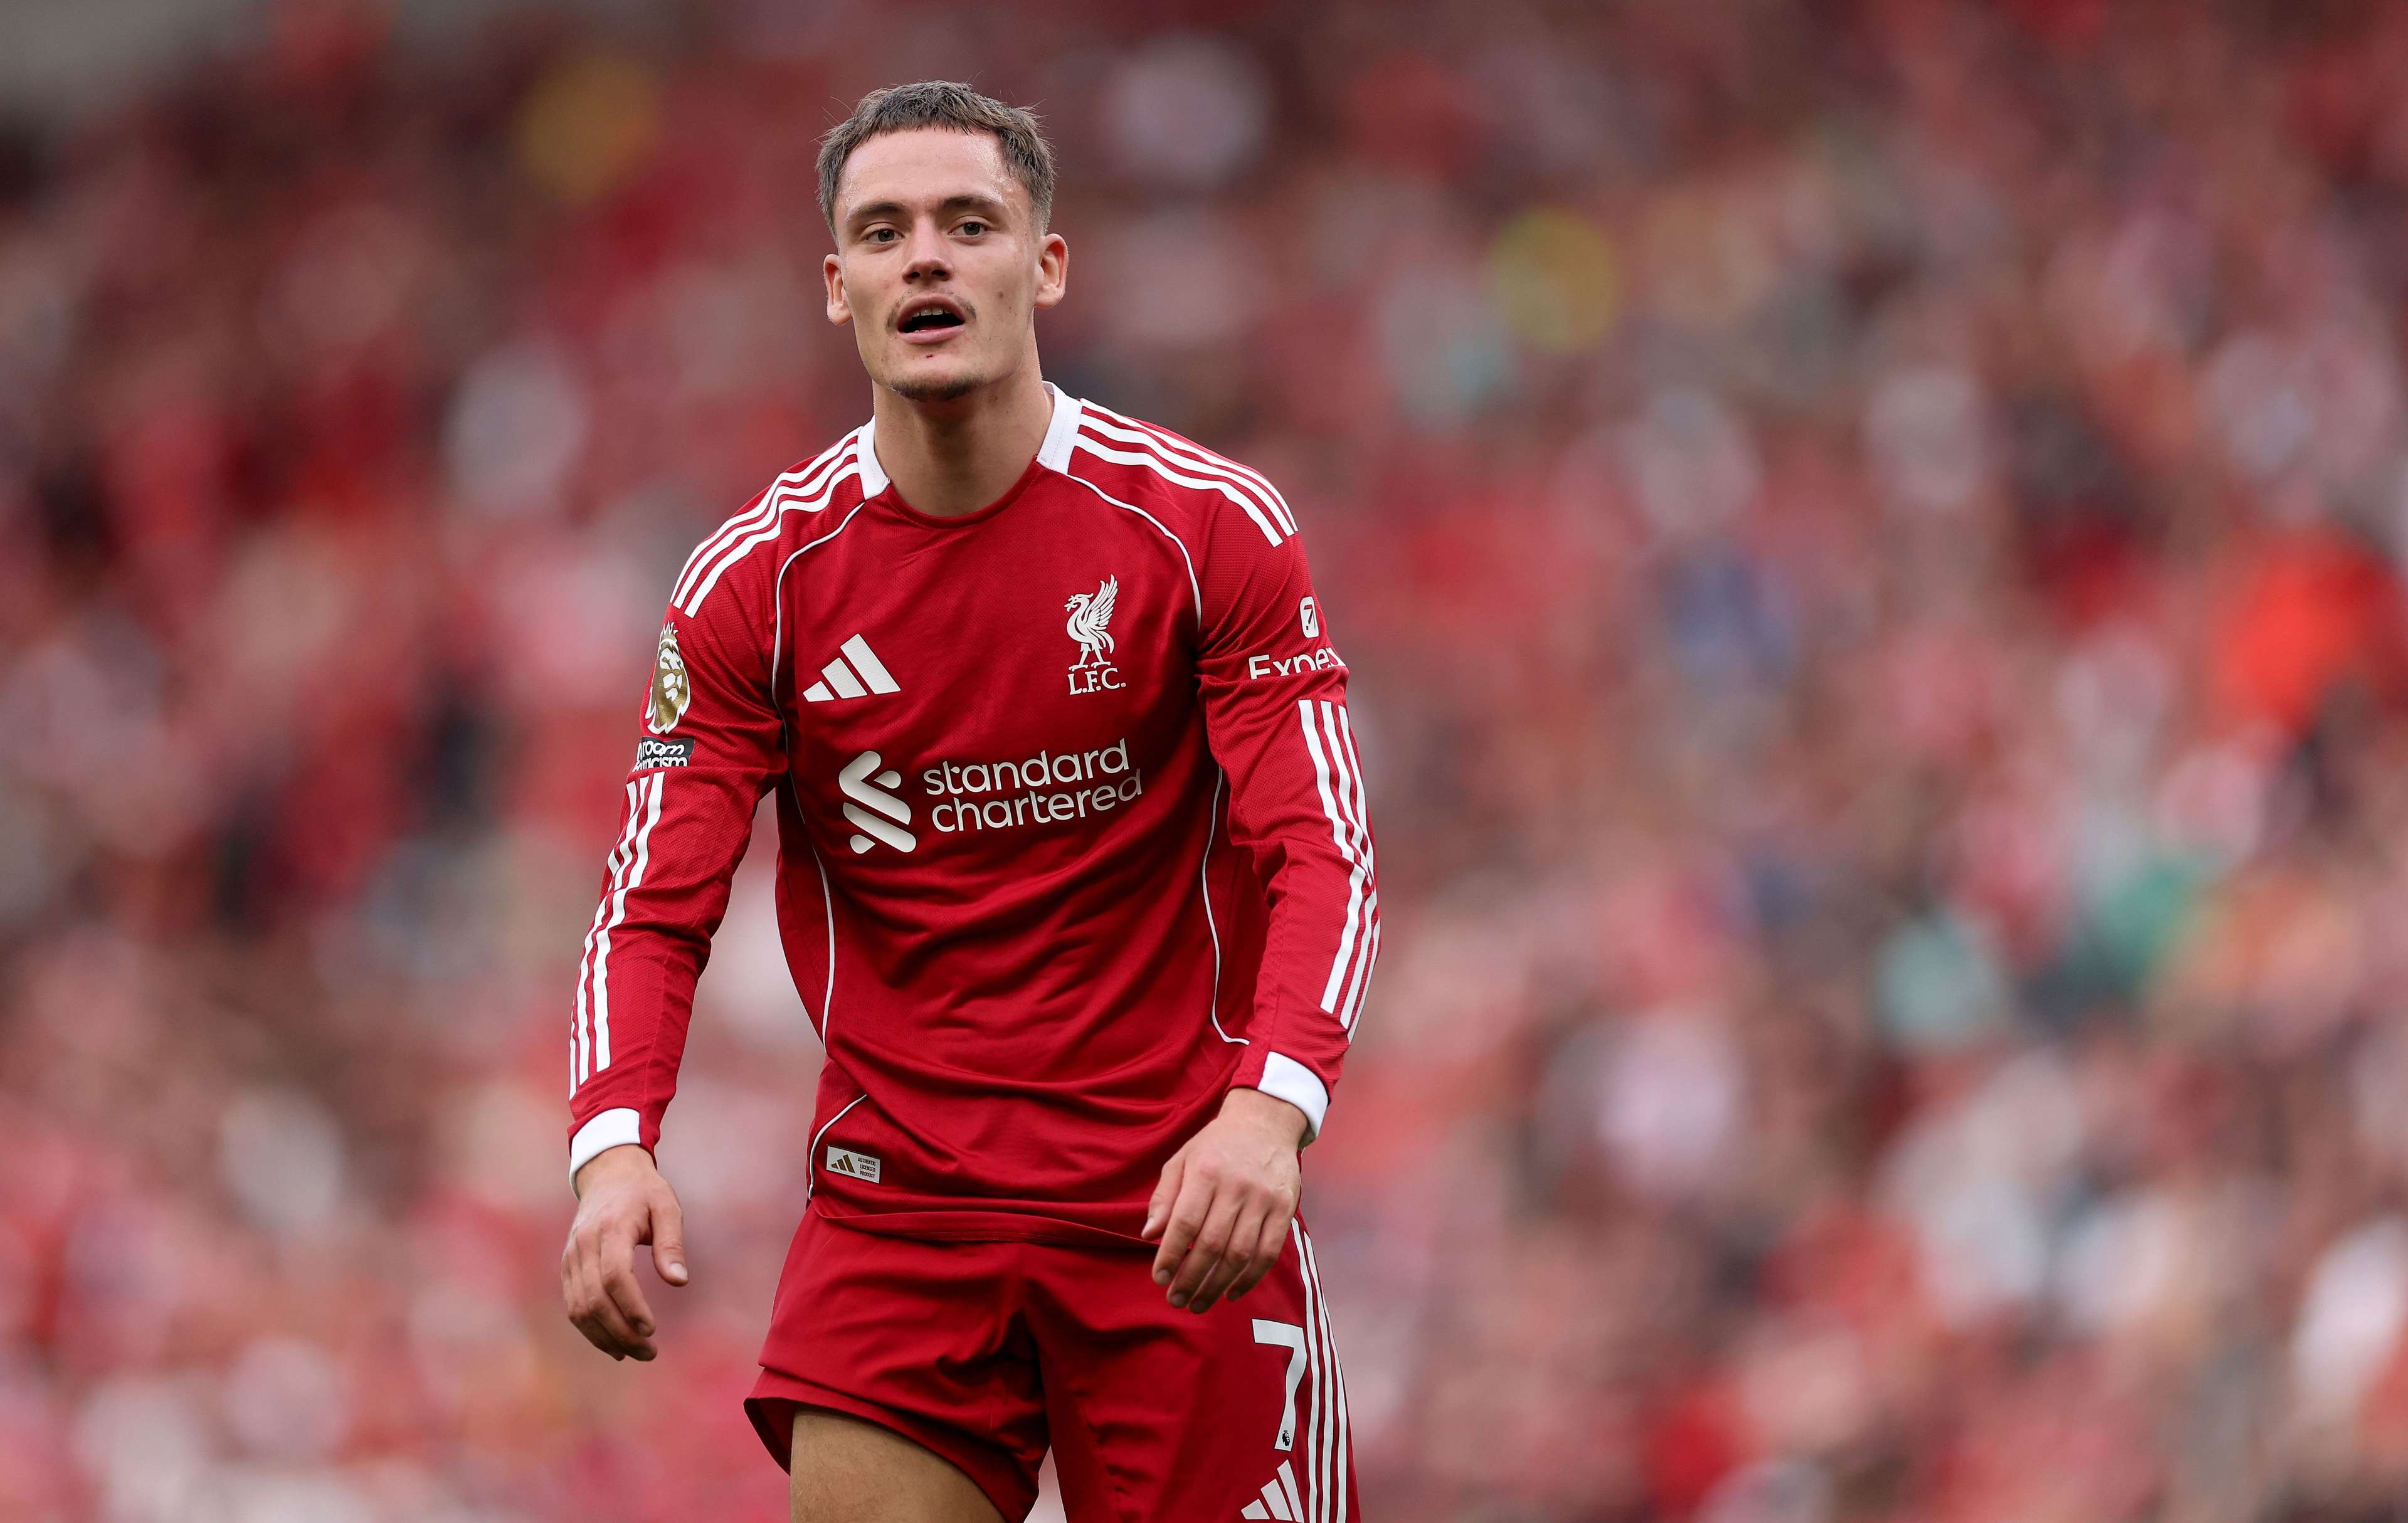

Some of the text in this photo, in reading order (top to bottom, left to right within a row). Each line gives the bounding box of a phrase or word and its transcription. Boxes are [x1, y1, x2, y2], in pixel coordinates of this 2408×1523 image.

[1067, 668, 1126, 695] L.F.C.
[923, 738, 1129, 796] standard
[932, 769, 1143, 833] chartered
[860, 1171, 875, 1179] PRODUCT
[1252, 1319, 1307, 1452] 7
